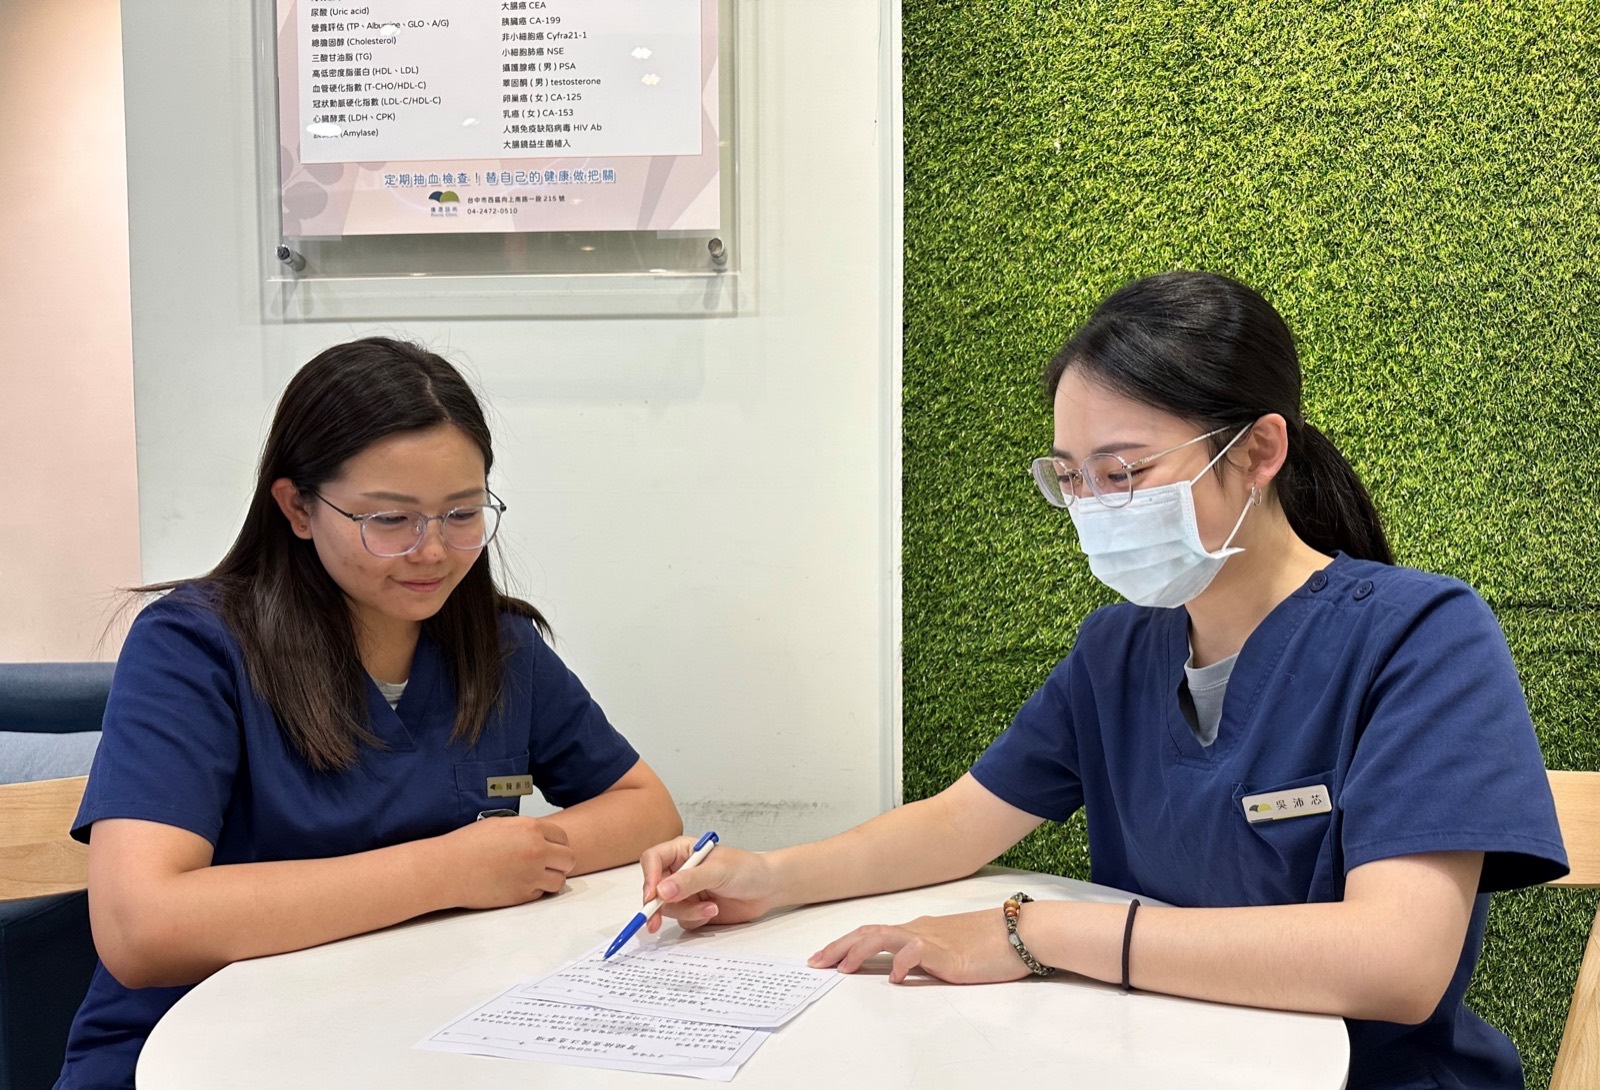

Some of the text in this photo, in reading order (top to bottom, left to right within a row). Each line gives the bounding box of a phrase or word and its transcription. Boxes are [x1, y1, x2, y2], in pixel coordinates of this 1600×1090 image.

[501, 1, 546, 11] 大腸癌 CEA
[311, 7, 370, 17] 尿酸 (Uric acid)
[501, 16, 561, 27] 胰臟癌 CA-199
[311, 23, 345, 33] 營養評估
[311, 36, 397, 48] 總膽固醇 (Cholesterol)
[502, 31, 587, 42] 非小細胞癌 Cyfra21-1
[312, 52, 373, 63] 三酸甘油脂 (TG)
[502, 47, 564, 57] 小細胞肺癌 NSE
[312, 67, 370, 78] 高低密度脂蛋白
[502, 63, 536, 73] 攝護腺癌
[559, 62, 576, 71] PSA
[312, 81, 427, 94] 血管硬化指數 (T-CHO/HDL-C)
[550, 78, 602, 86] testosterone
[381, 96, 441, 107] (LDL-C/HDL-C)
[502, 93, 528, 104] 卵巢癌
[550, 93, 582, 102] CA-125
[313, 113, 347, 124] 心臟酵素
[502, 109, 520, 119] 乳癌
[542, 108, 574, 117] CA-153
[340, 128, 379, 139] (Amylase)
[502, 123, 603, 135] 人類免疫缺陷病毒 HIV Ab
[503, 139, 571, 150] 大腸鏡益生菌植入
[467, 207, 519, 215] 04-2472-0510
